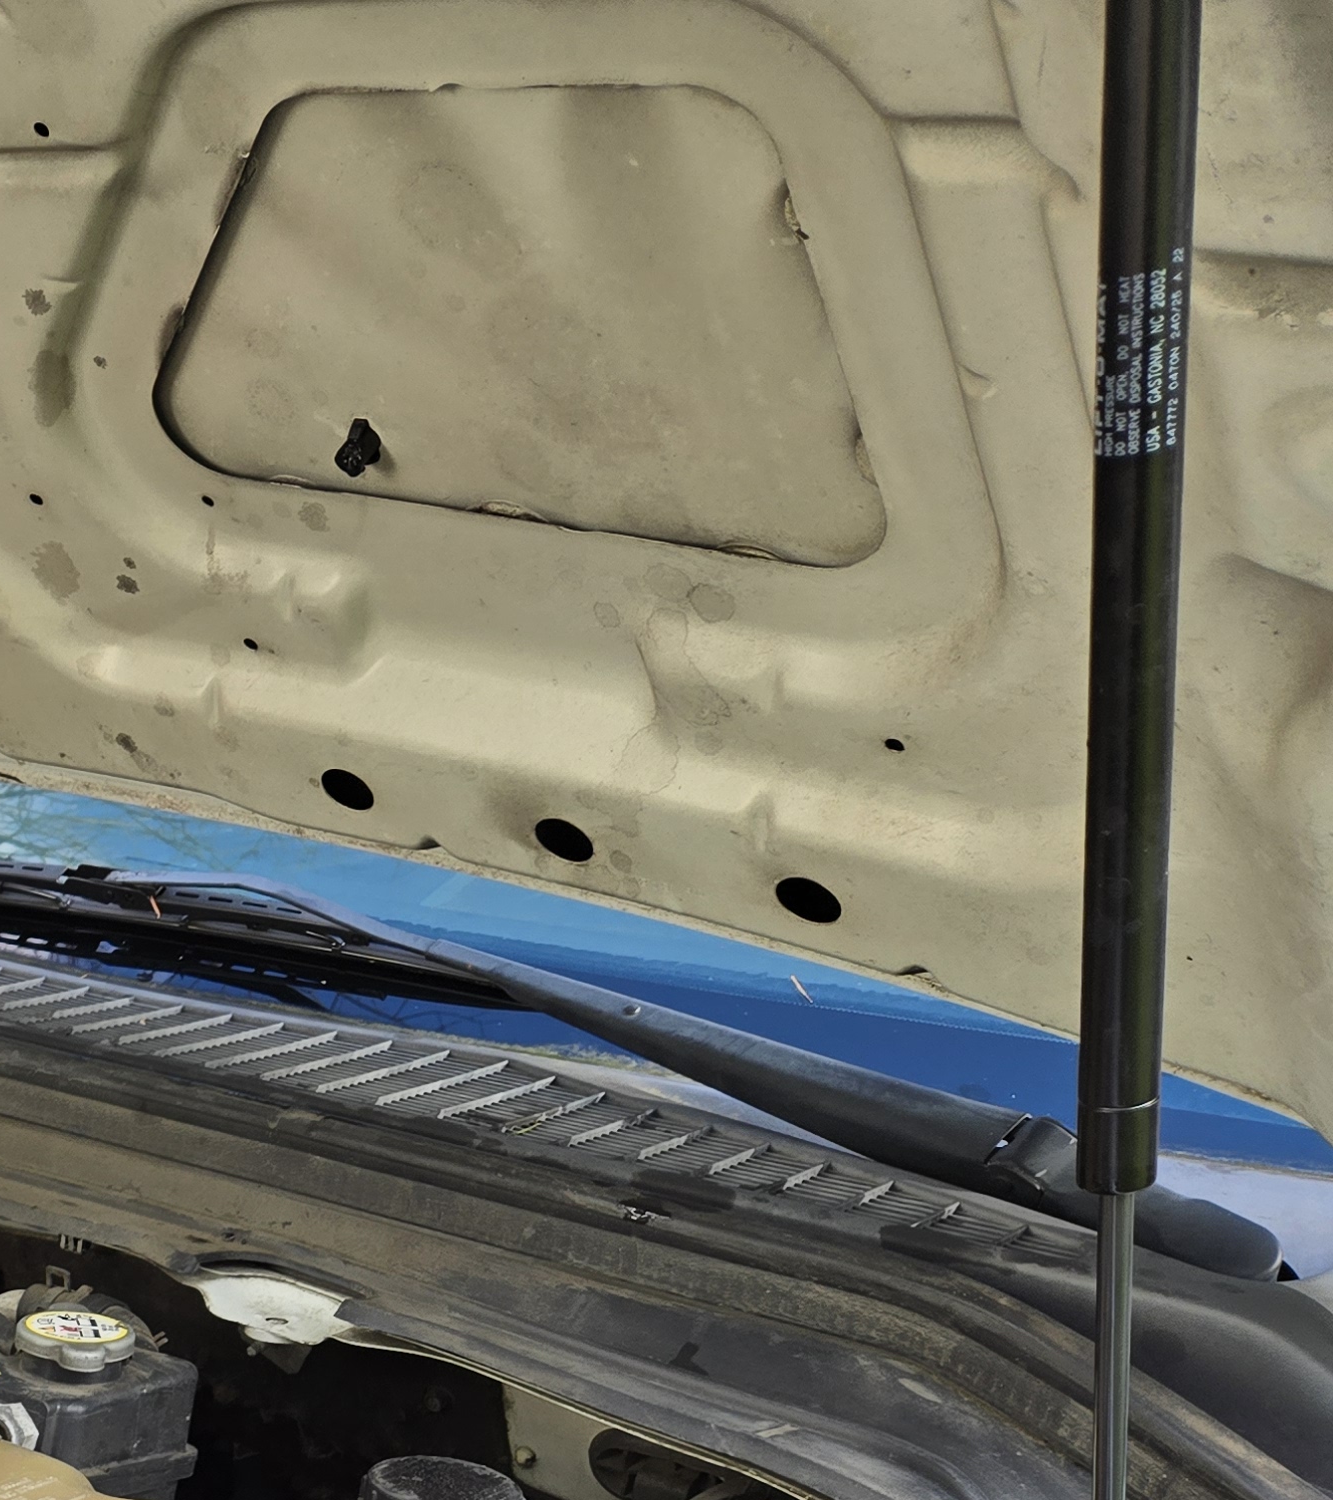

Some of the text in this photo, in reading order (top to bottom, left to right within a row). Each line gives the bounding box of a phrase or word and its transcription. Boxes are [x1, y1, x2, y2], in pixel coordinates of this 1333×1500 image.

[1172, 247, 1185, 263] 22
[1120, 276, 1130, 304] HEAT
[1150, 268, 1167, 311] 28052
[1119, 314, 1130, 334] NOT
[1149, 314, 1164, 338] NC
[1119, 346, 1128, 361] DO
[1128, 272, 1145, 455] OBSERVE DISPOSAL INSTRUCTIONS
[1147, 338, 1164, 403] GASTONIA,
[1105, 375, 1117, 427] PRESSURE
[1117, 412, 1128, 432] NOT
[1115, 442, 1127, 457] DO
[1146, 426, 1161, 453] USA
